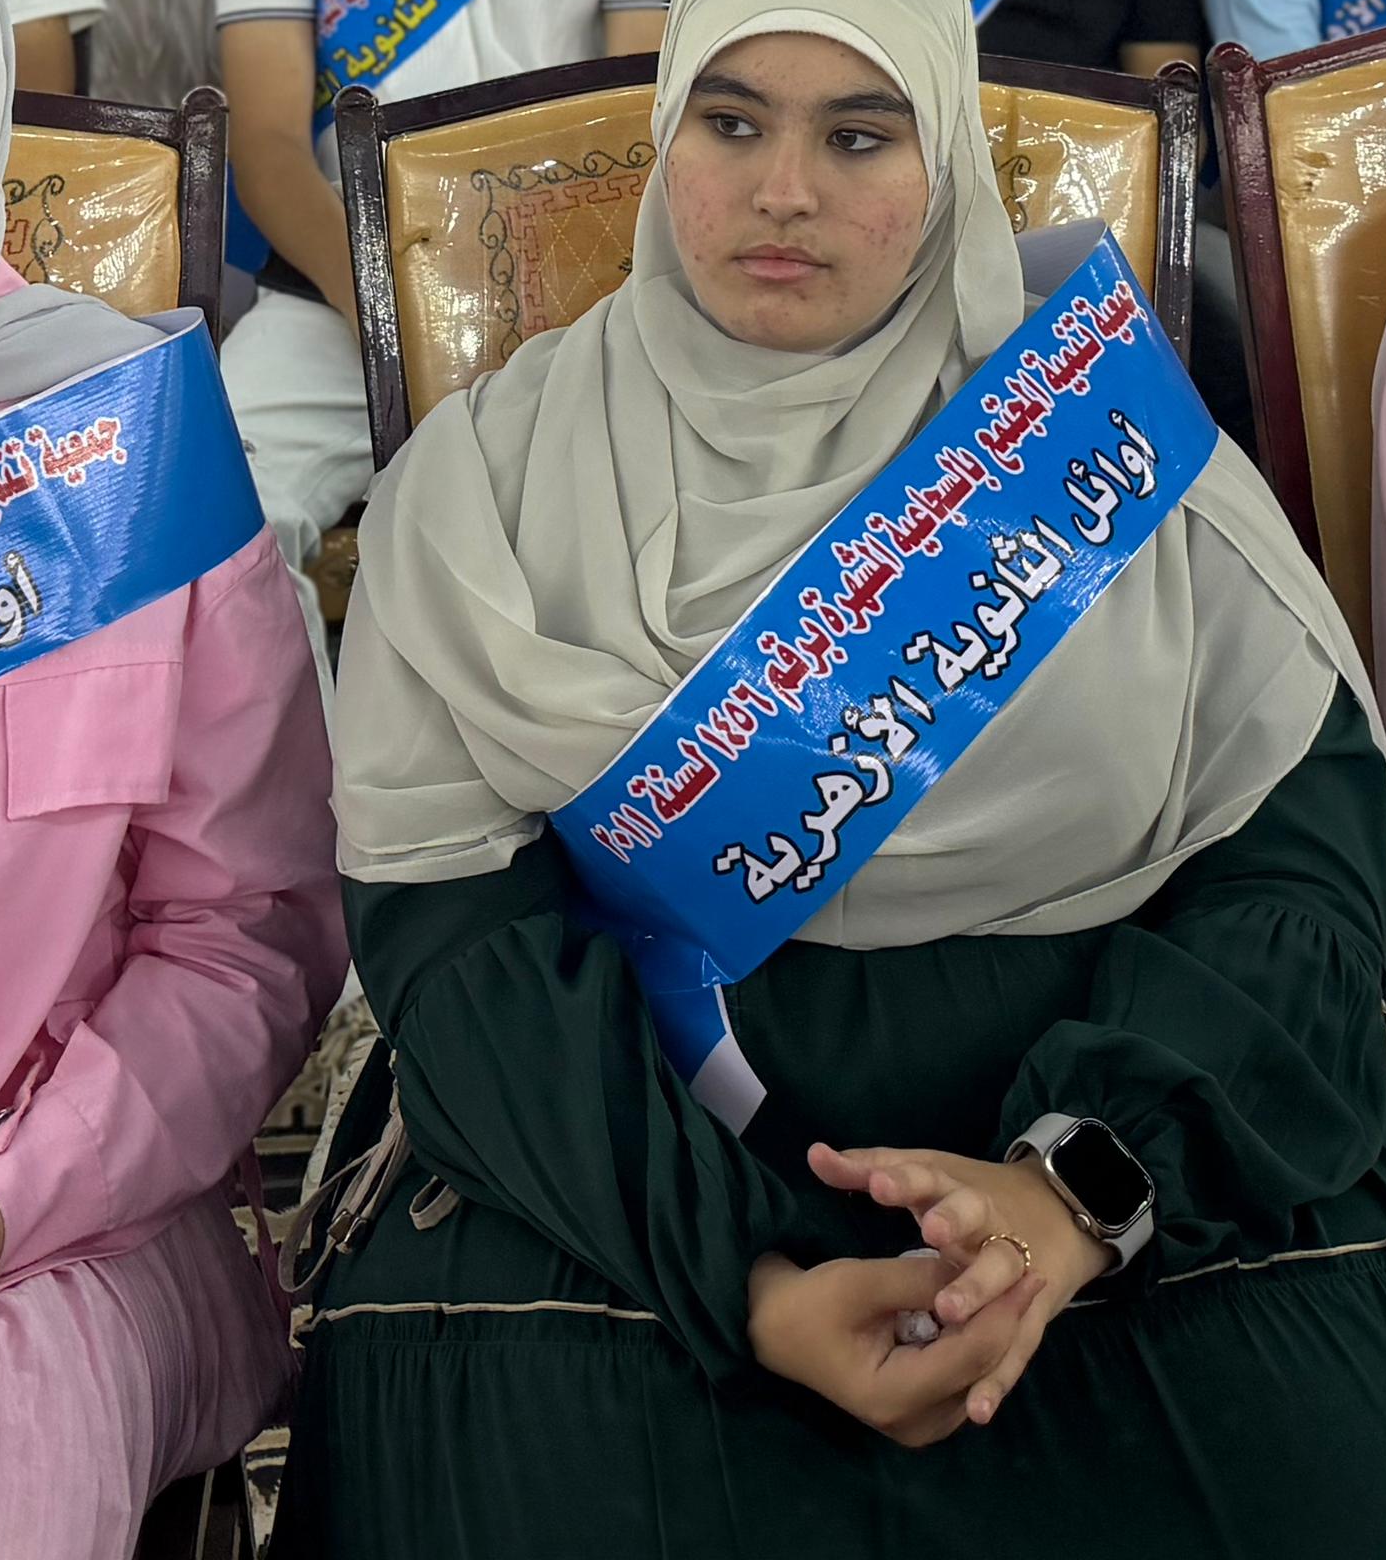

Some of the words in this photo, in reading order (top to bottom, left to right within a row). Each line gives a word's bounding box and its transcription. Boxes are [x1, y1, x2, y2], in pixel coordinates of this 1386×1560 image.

[1019, 311, 1105, 396] تنمية
[1071, 280, 1150, 344] جمعية
[24, 417, 129, 485] جمعية
[975, 368, 1055, 474] المجتمع
[864, 446, 1002, 557] بالسجاعية
[1062, 408, 1160, 547] أوائل
[798, 531, 905, 632] المشهرة
[902, 514, 1076, 693] الثانوية
[757, 616, 849, 713] برقم
[695, 680, 779, 762] ١٤٥٦
[626, 739, 721, 825] لسنة
[713, 675, 936, 904] الأزهرية
[590, 803, 663, 865] ٢٠١١
